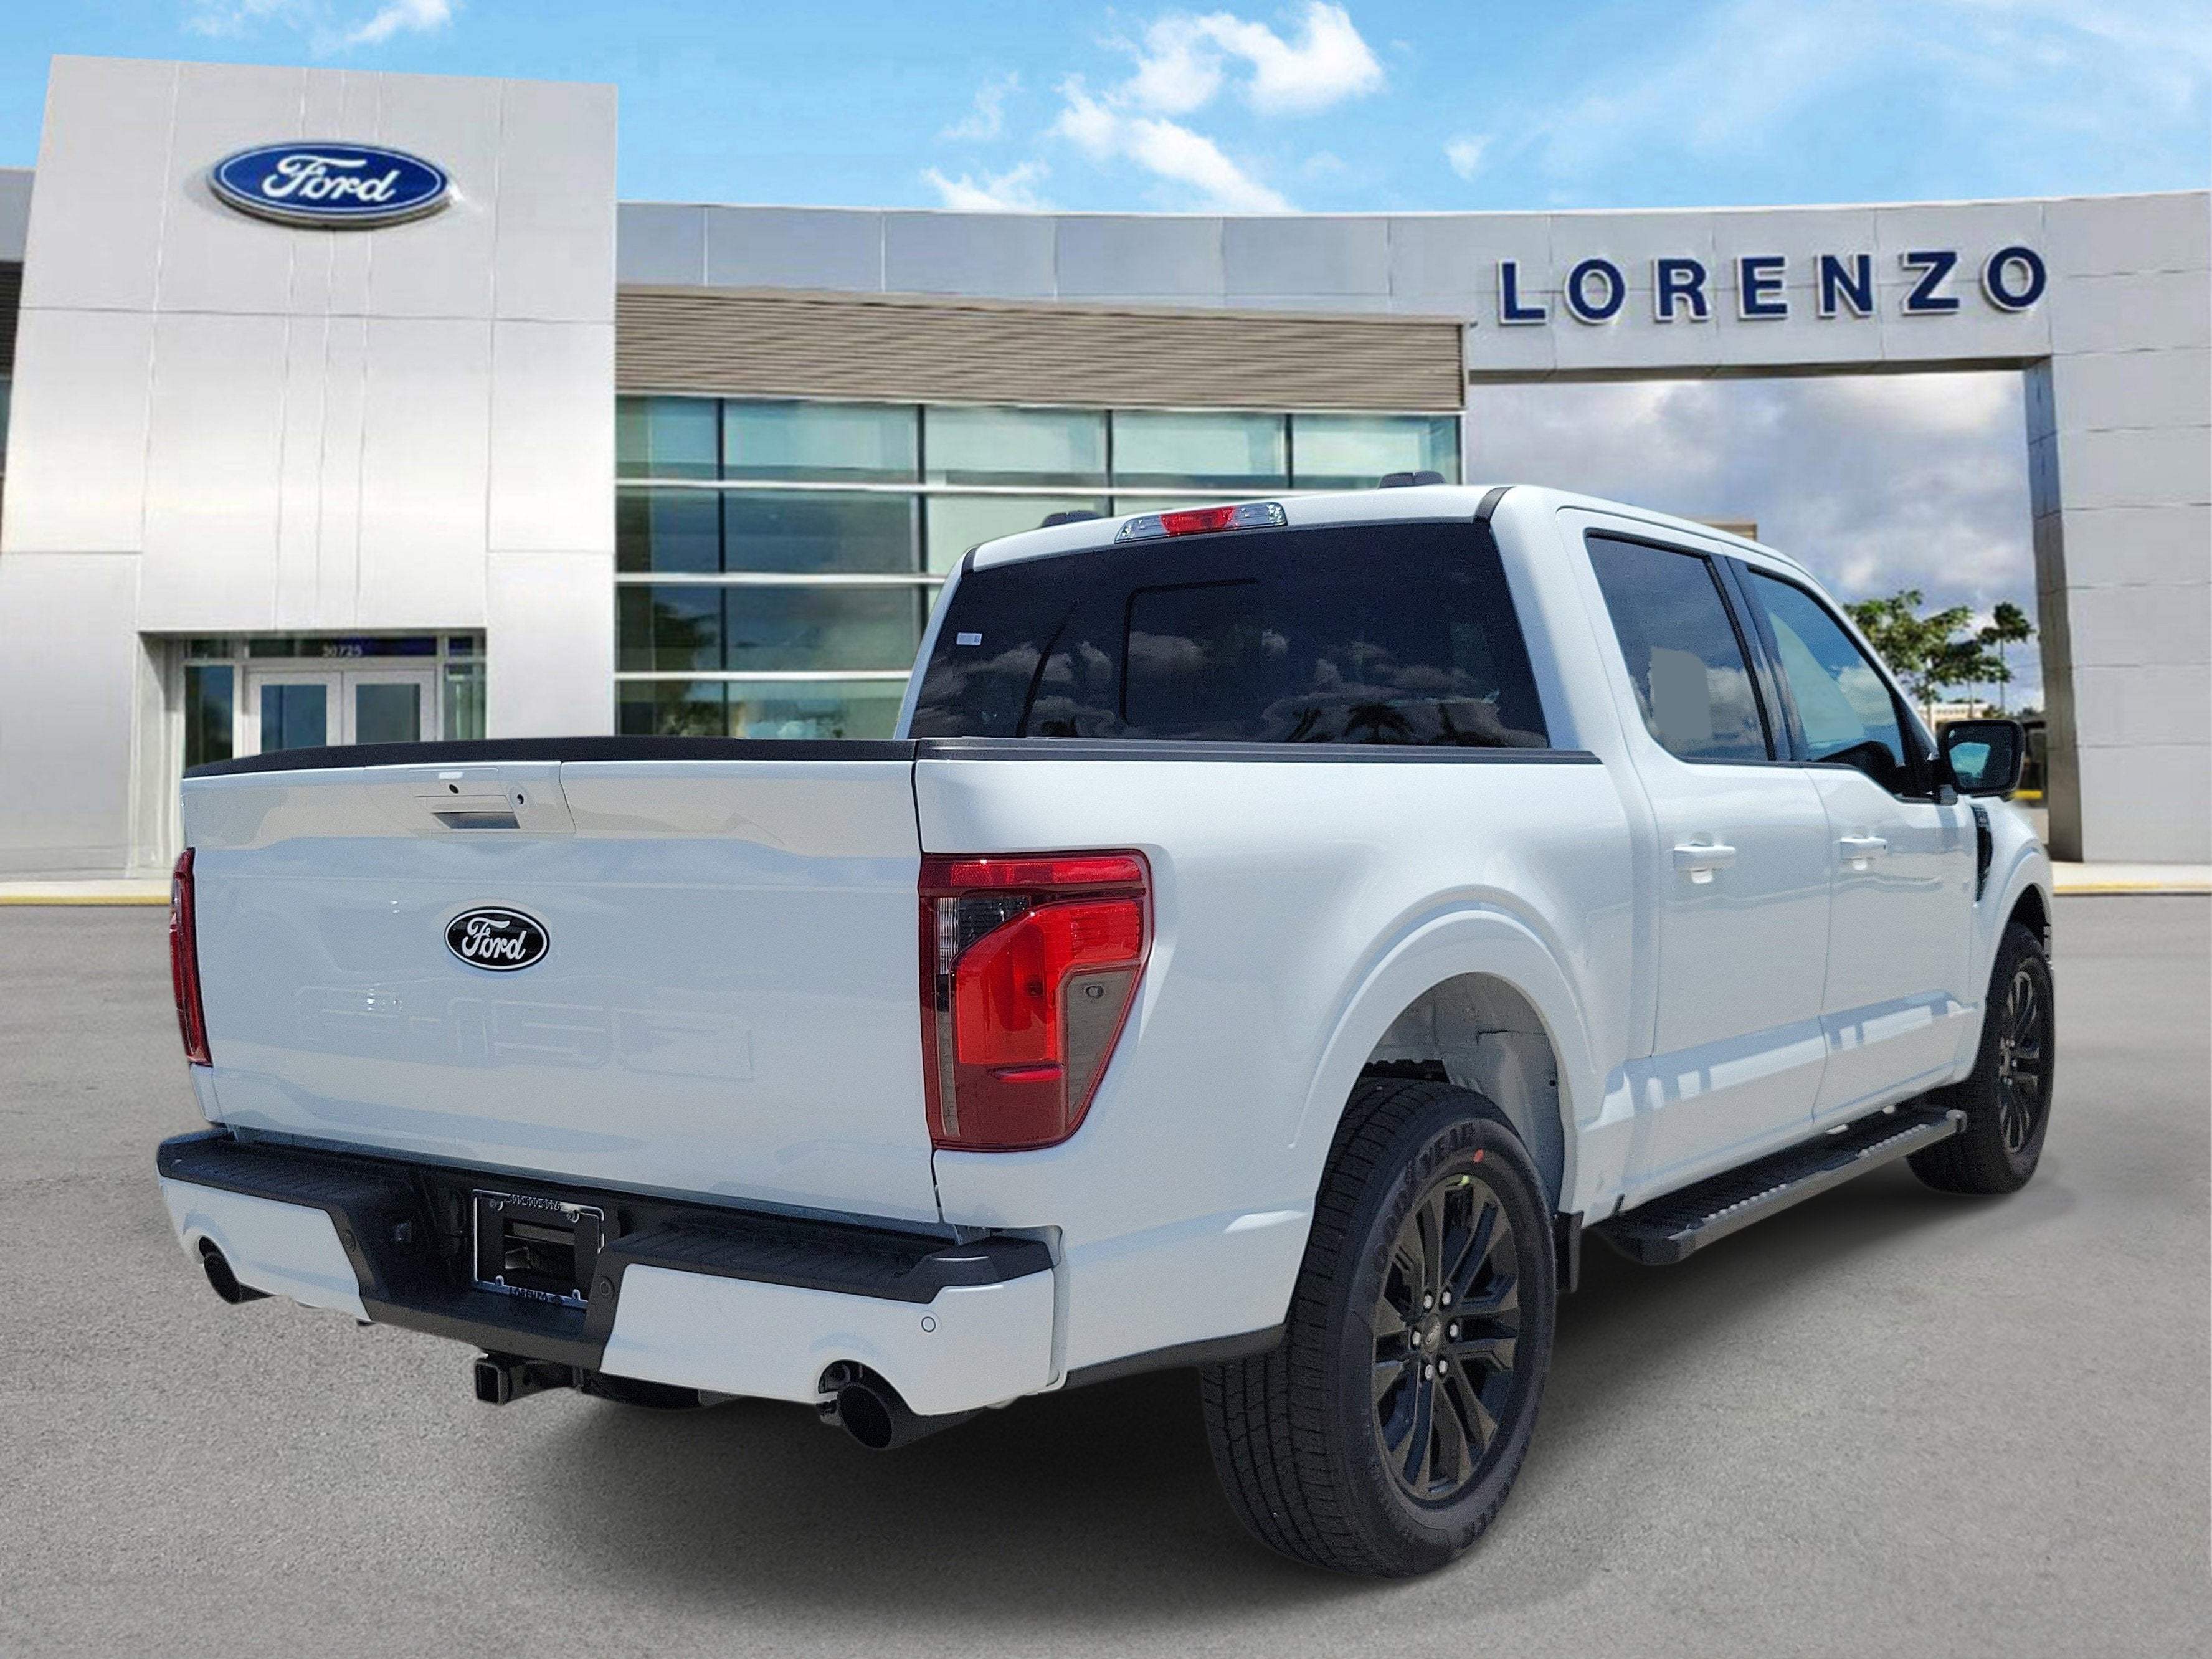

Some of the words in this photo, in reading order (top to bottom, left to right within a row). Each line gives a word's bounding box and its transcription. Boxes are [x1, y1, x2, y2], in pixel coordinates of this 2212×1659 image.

[262, 154, 401, 202] Ford
[1498, 245, 2048, 325] LORENZO
[461, 916, 528, 961] Ford
